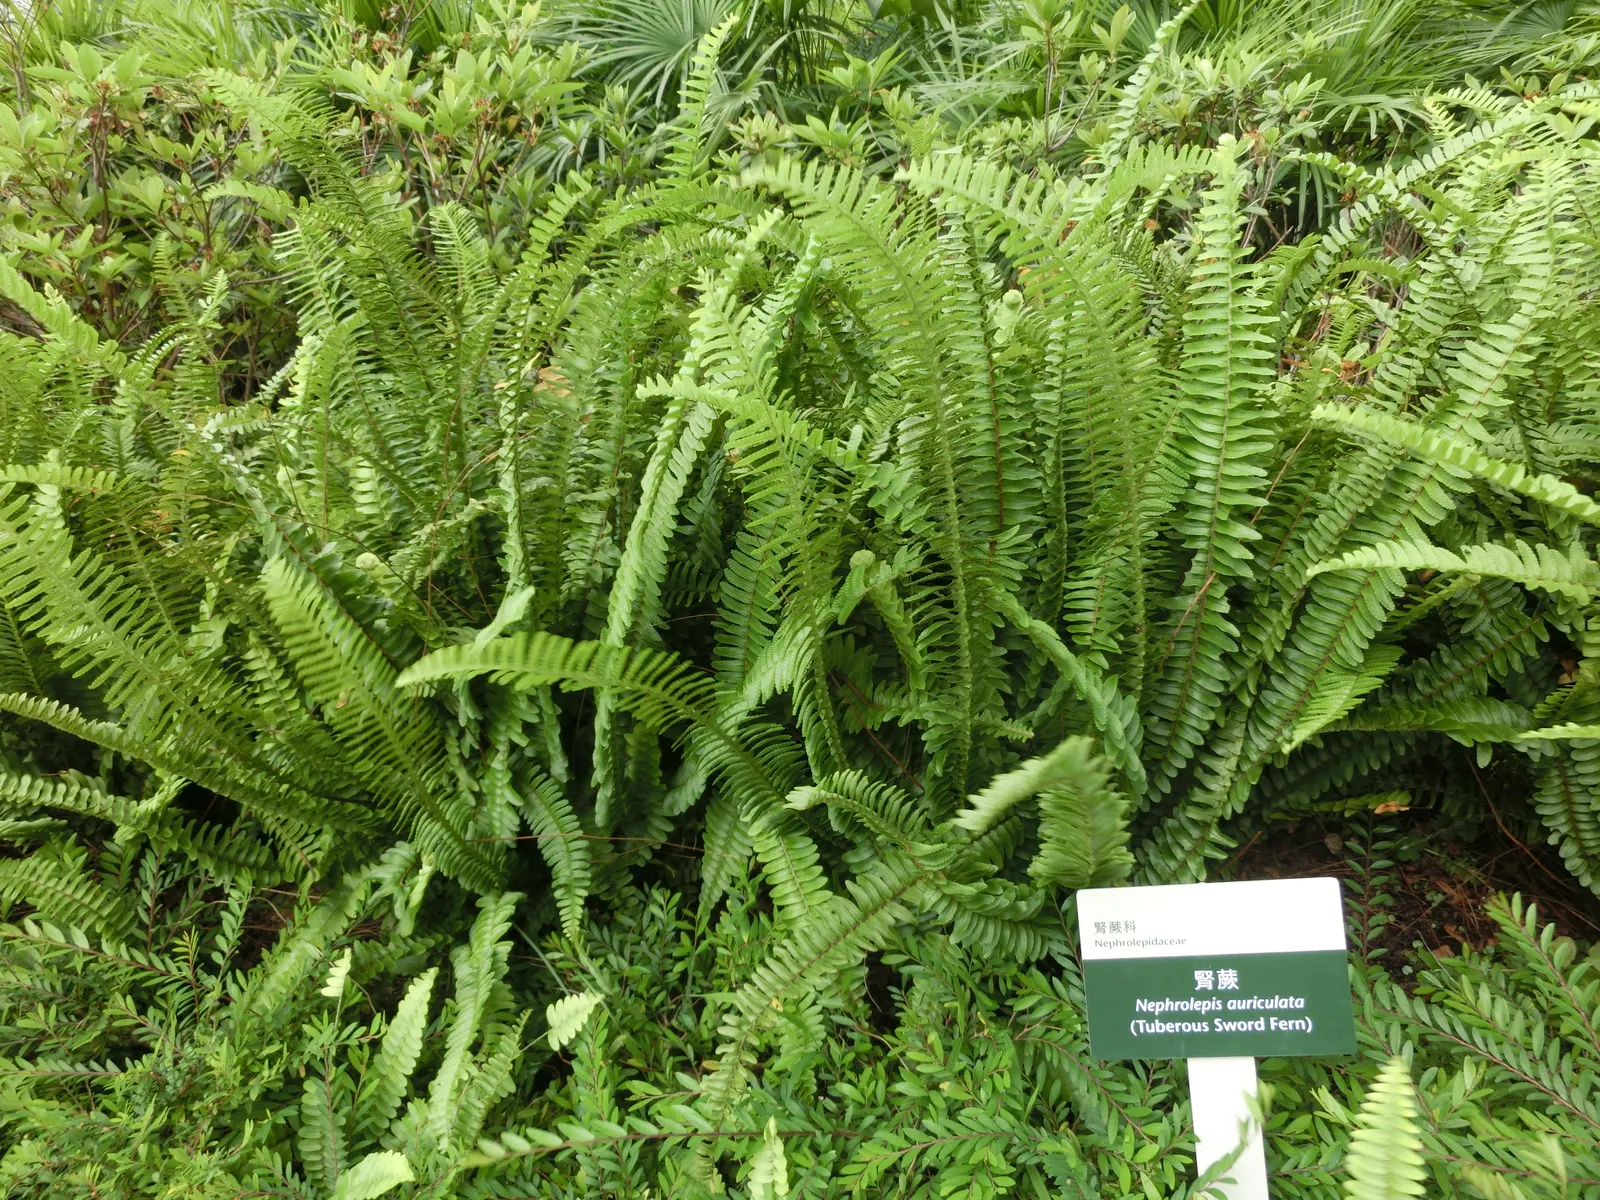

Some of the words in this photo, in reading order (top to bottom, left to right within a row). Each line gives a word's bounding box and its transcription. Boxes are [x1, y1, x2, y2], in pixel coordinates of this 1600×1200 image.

[1093, 920, 1137, 935] 腎蕨科
[1094, 936, 1187, 949] Nephrolepidaceae
[1193, 968, 1240, 991] 腎蕨
[1135, 996, 1223, 1016] Nephrolepis
[1226, 994, 1306, 1011] auriculata
[1130, 1018, 1210, 1036] (Tuberous
[1213, 1016, 1266, 1033] Sword
[1269, 1015, 1313, 1033] Fern)
